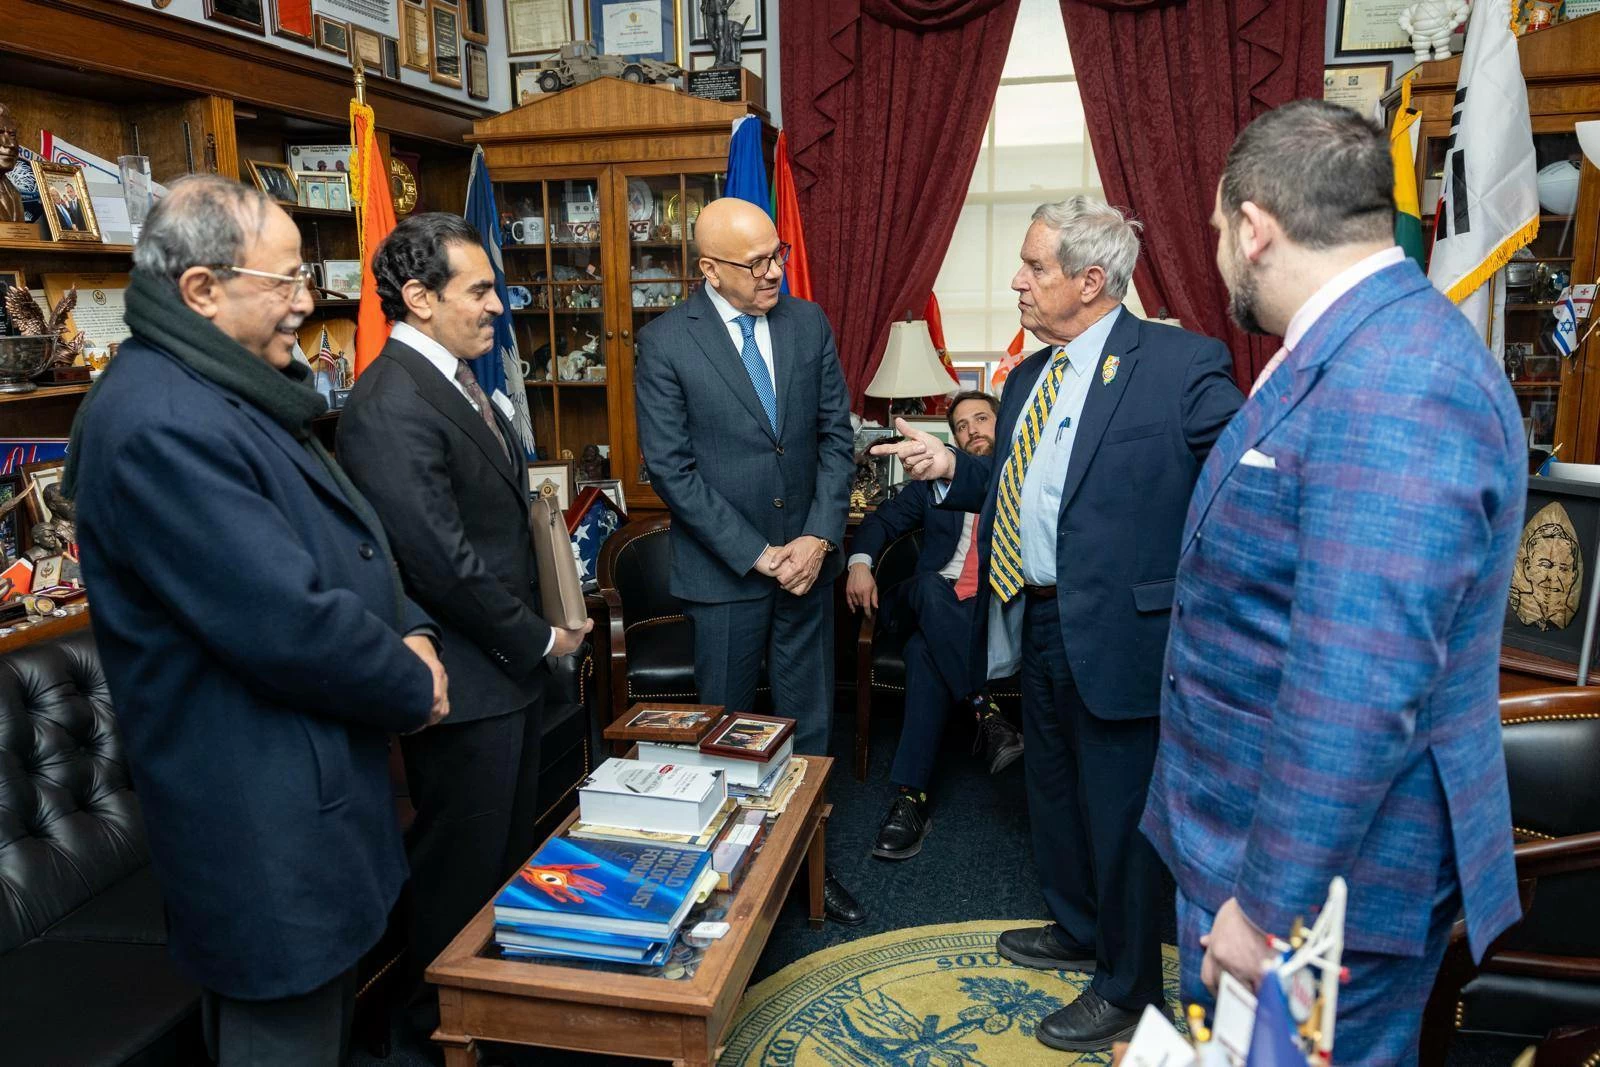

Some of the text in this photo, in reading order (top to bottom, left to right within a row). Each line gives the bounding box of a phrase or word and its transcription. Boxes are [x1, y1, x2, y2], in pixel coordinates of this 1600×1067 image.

[624, 848, 662, 883] FORUM
[628, 850, 682, 909] HOLOCAUST
[665, 853, 702, 887] WORLD
[937, 952, 1001, 969] SOU
